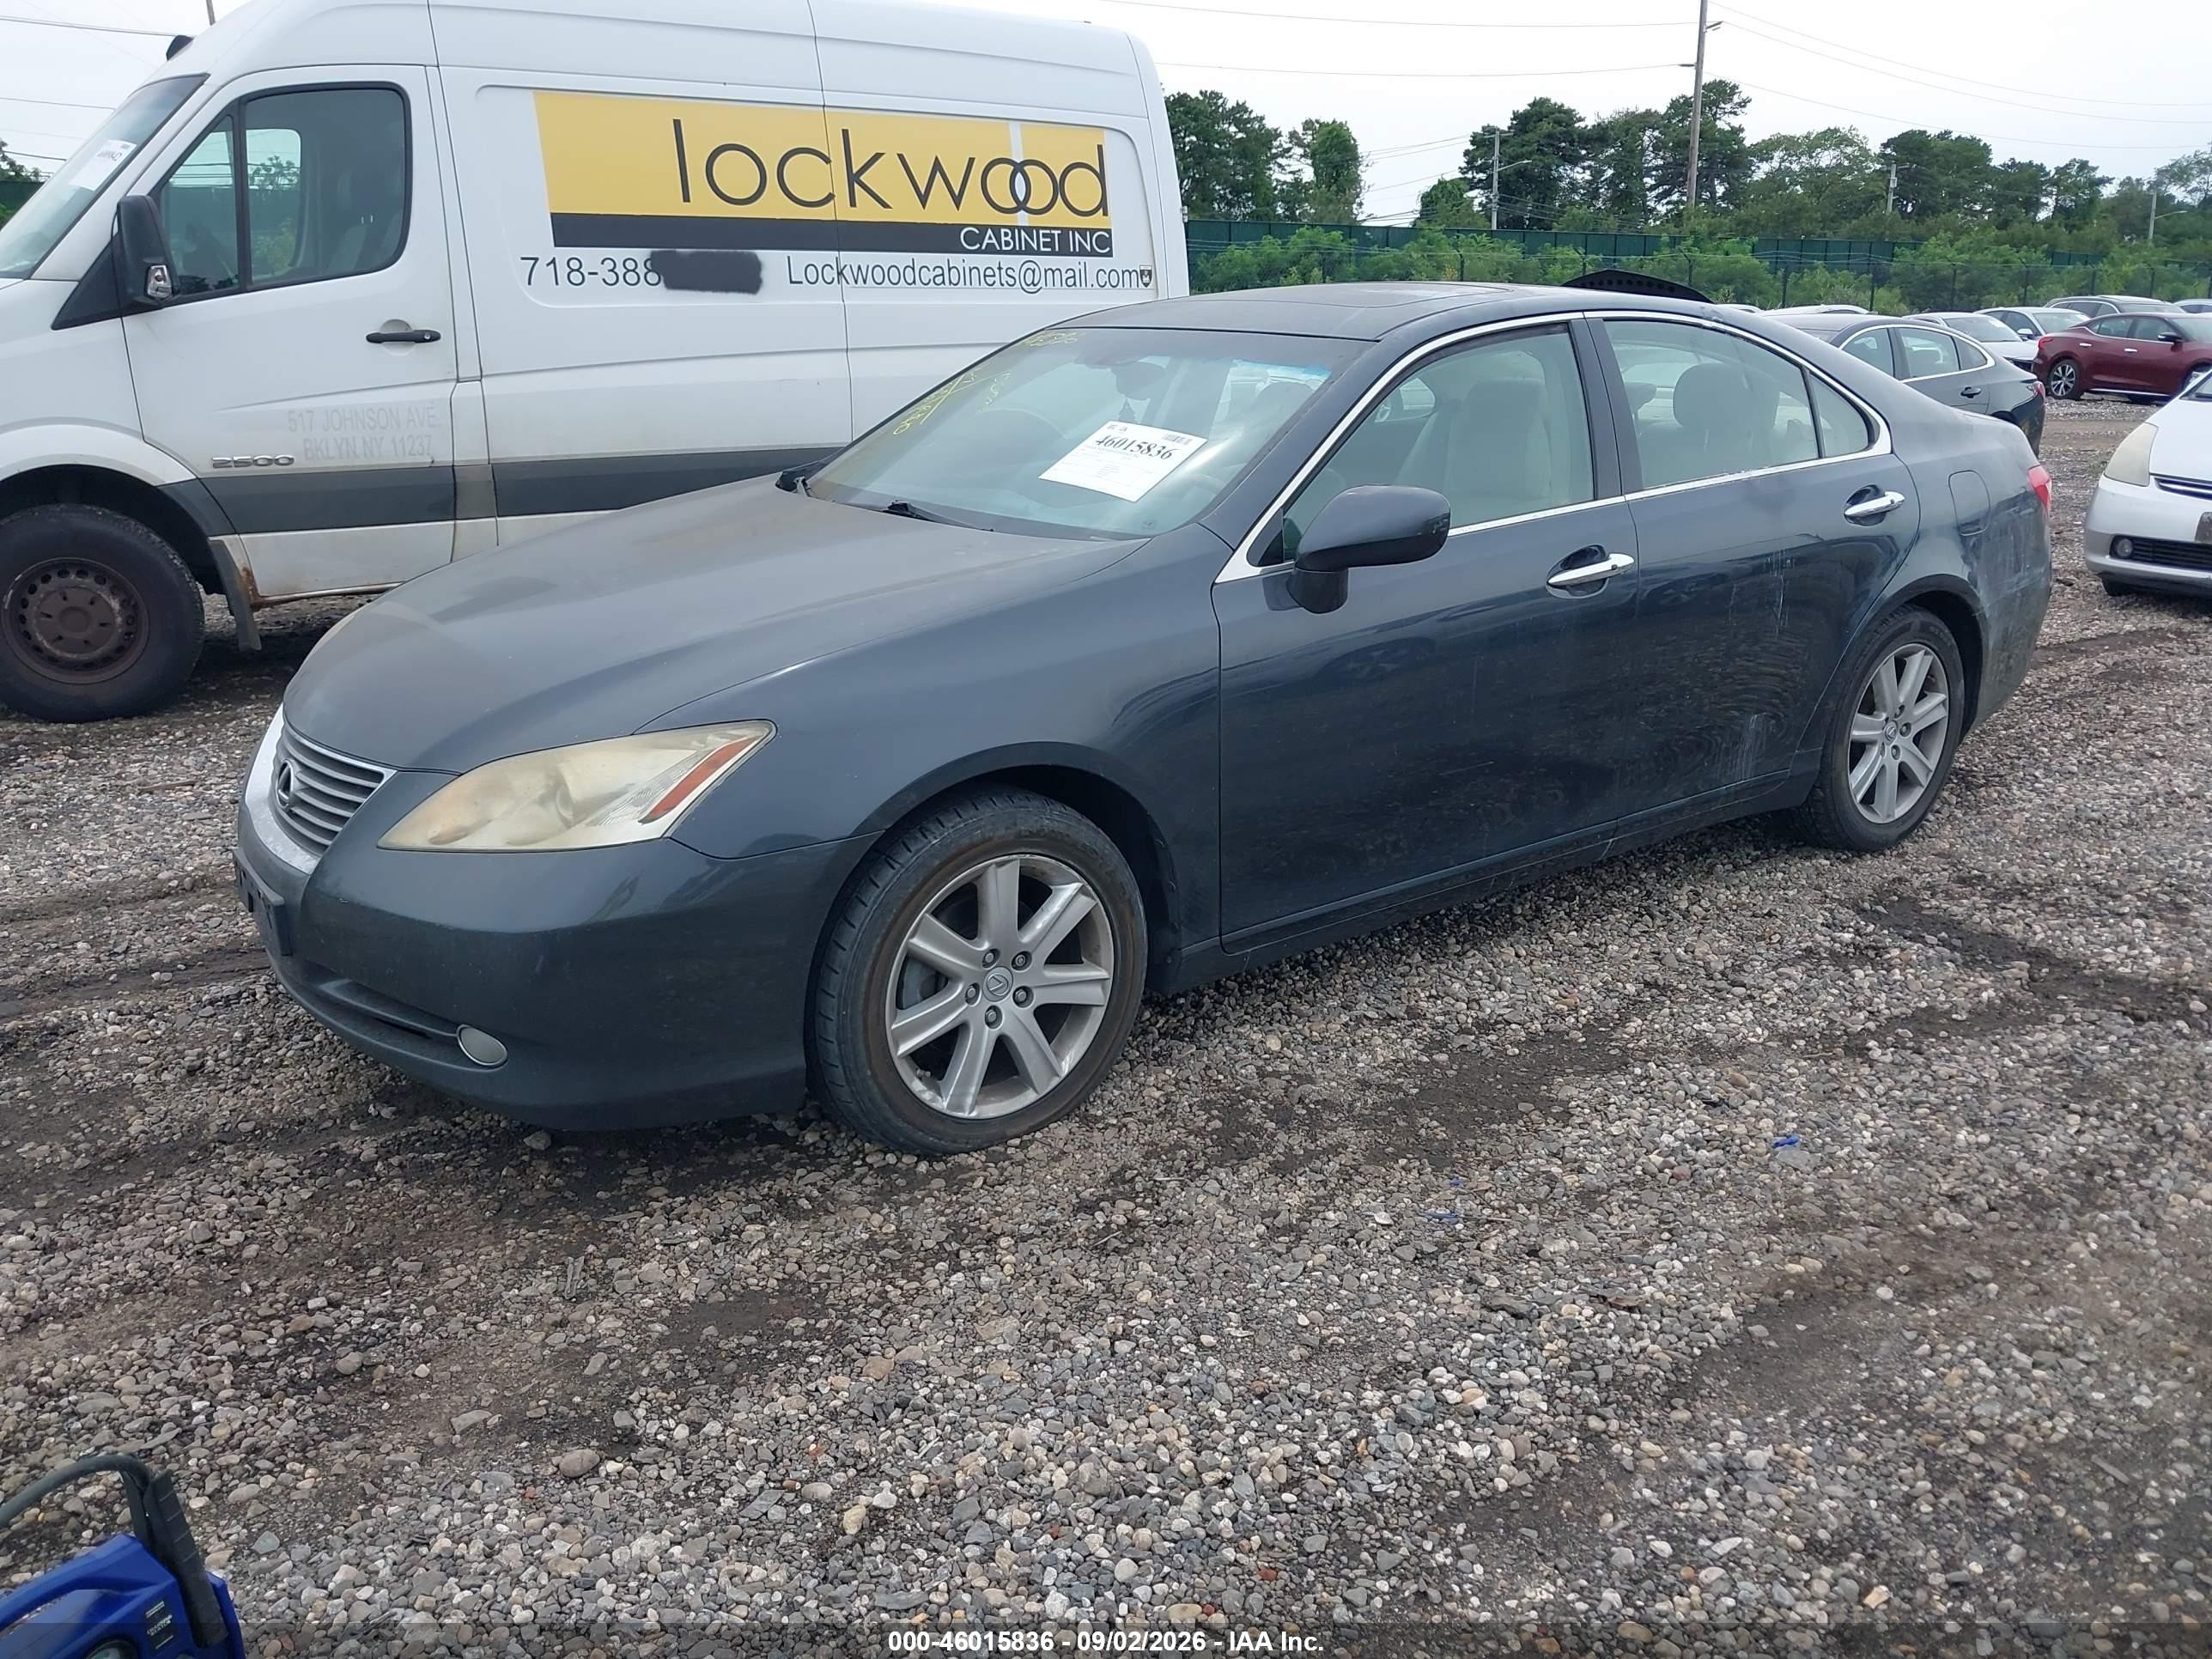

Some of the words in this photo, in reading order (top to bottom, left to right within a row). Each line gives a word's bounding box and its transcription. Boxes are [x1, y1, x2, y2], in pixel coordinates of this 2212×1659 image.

[672, 118, 1109, 217] lockwood
[960, 227, 1062, 252] CABINET
[1069, 230, 1111, 254] INC
[787, 255, 1139, 294] Lockwoodcabinets@mail.com
[288, 410, 315, 432] 517
[322, 406, 401, 432] JOHNSON
[391, 434, 433, 457] 11237
[1096, 434, 1181, 460] 46015836
[212, 454, 295, 469] 2500
